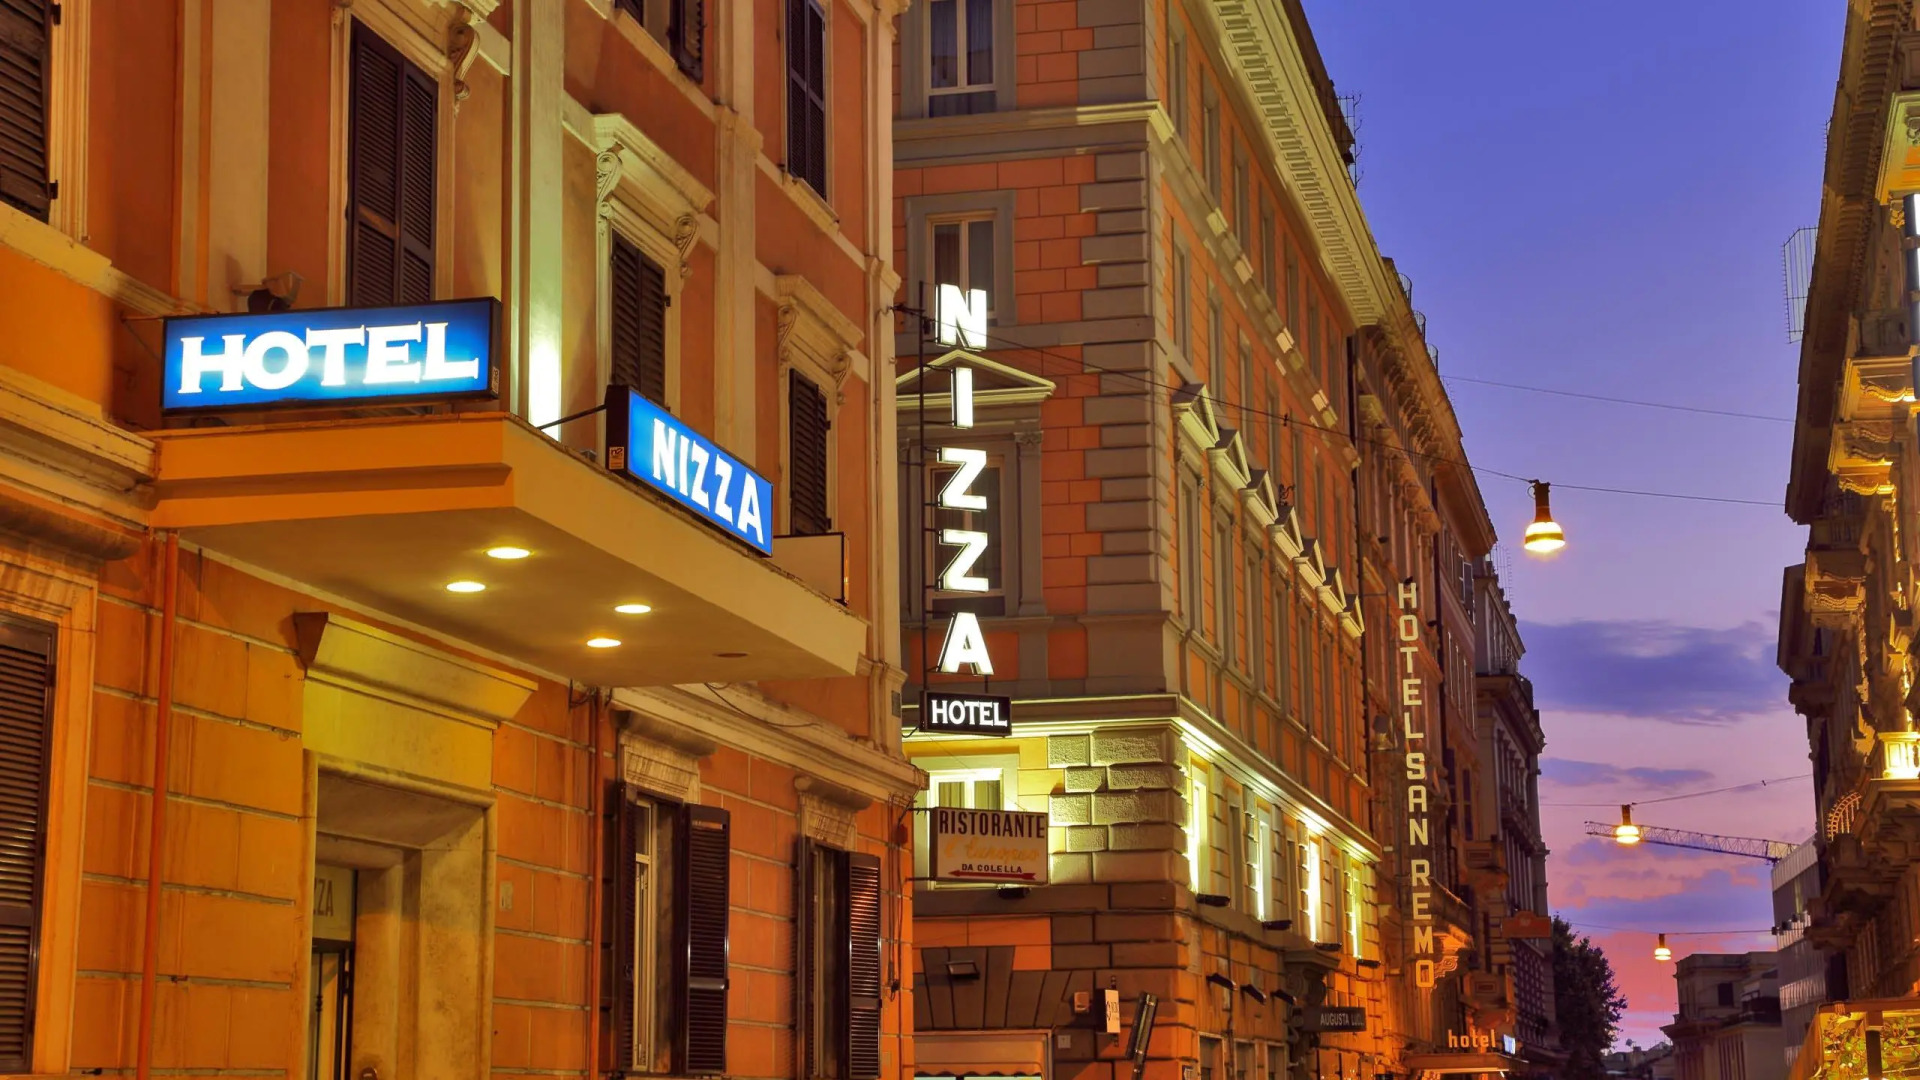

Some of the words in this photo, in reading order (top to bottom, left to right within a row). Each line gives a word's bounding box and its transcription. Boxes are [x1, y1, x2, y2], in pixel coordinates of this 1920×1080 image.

[179, 321, 480, 395] HOTEL
[652, 417, 765, 545] NIZZA
[936, 284, 994, 675] NIZZA
[1398, 583, 1425, 739] HOTEL
[931, 699, 1008, 727] HOTEL
[939, 810, 1045, 838] RISTORANTE
[1406, 752, 1429, 846] SAN
[962, 863, 974, 871] DA
[977, 864, 1023, 873] COLELLA
[1411, 859, 1435, 988] REMO
[1321, 1013, 1350, 1026] AUGUSTA
[1448, 1029, 1497, 1048] hotel
